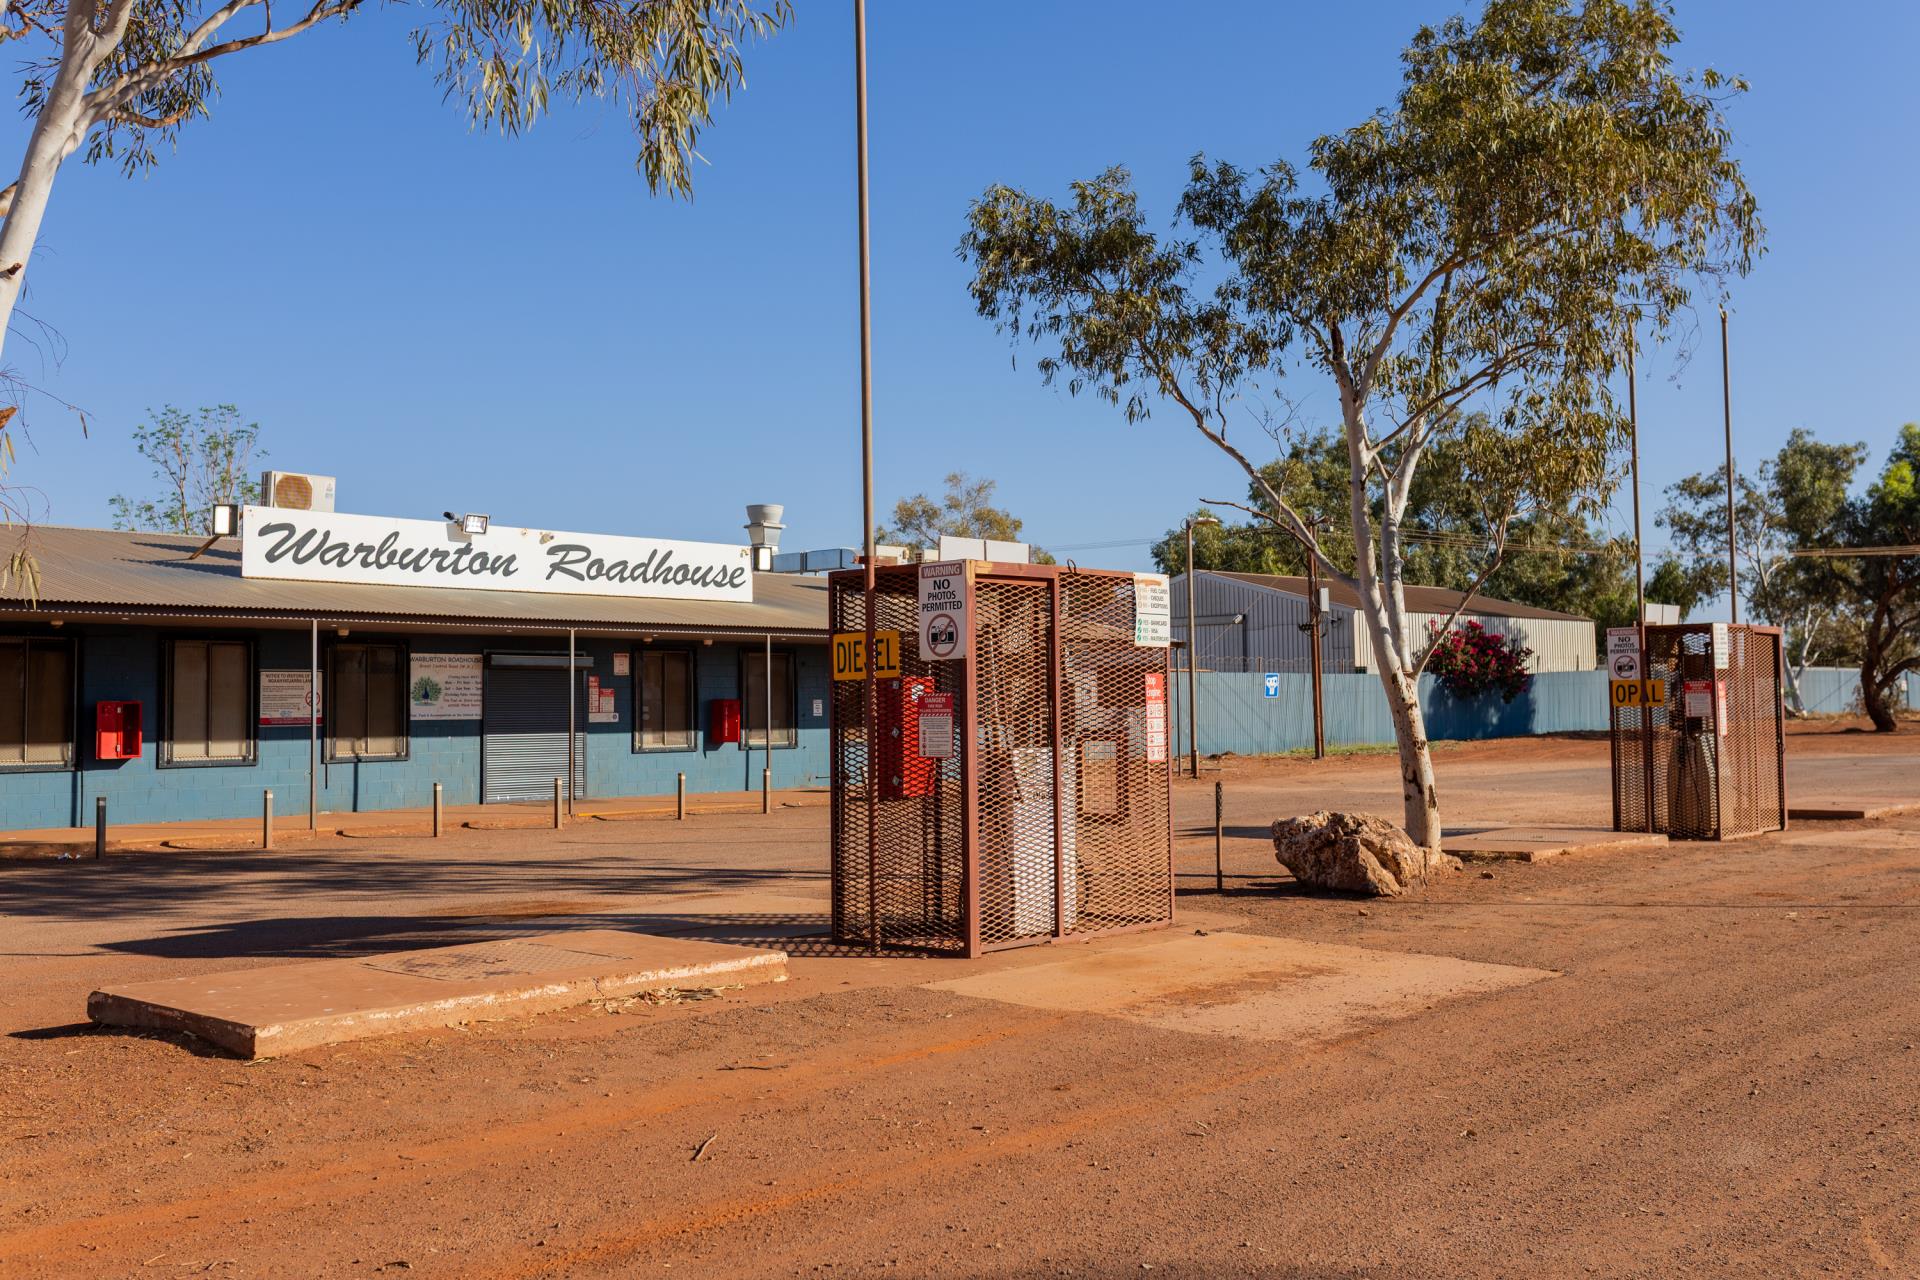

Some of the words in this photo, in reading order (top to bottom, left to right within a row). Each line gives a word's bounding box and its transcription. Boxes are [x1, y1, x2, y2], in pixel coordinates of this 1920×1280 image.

[258, 522, 518, 577] Warburton
[546, 544, 746, 588] Roadhouse
[923, 565, 960, 577] WARNING
[933, 579, 950, 590] NO
[928, 591, 956, 602] PHOTOS
[922, 600, 962, 612] PERMITTED
[837, 638, 896, 673] DIEEL
[1145, 676, 1156, 687] Stop
